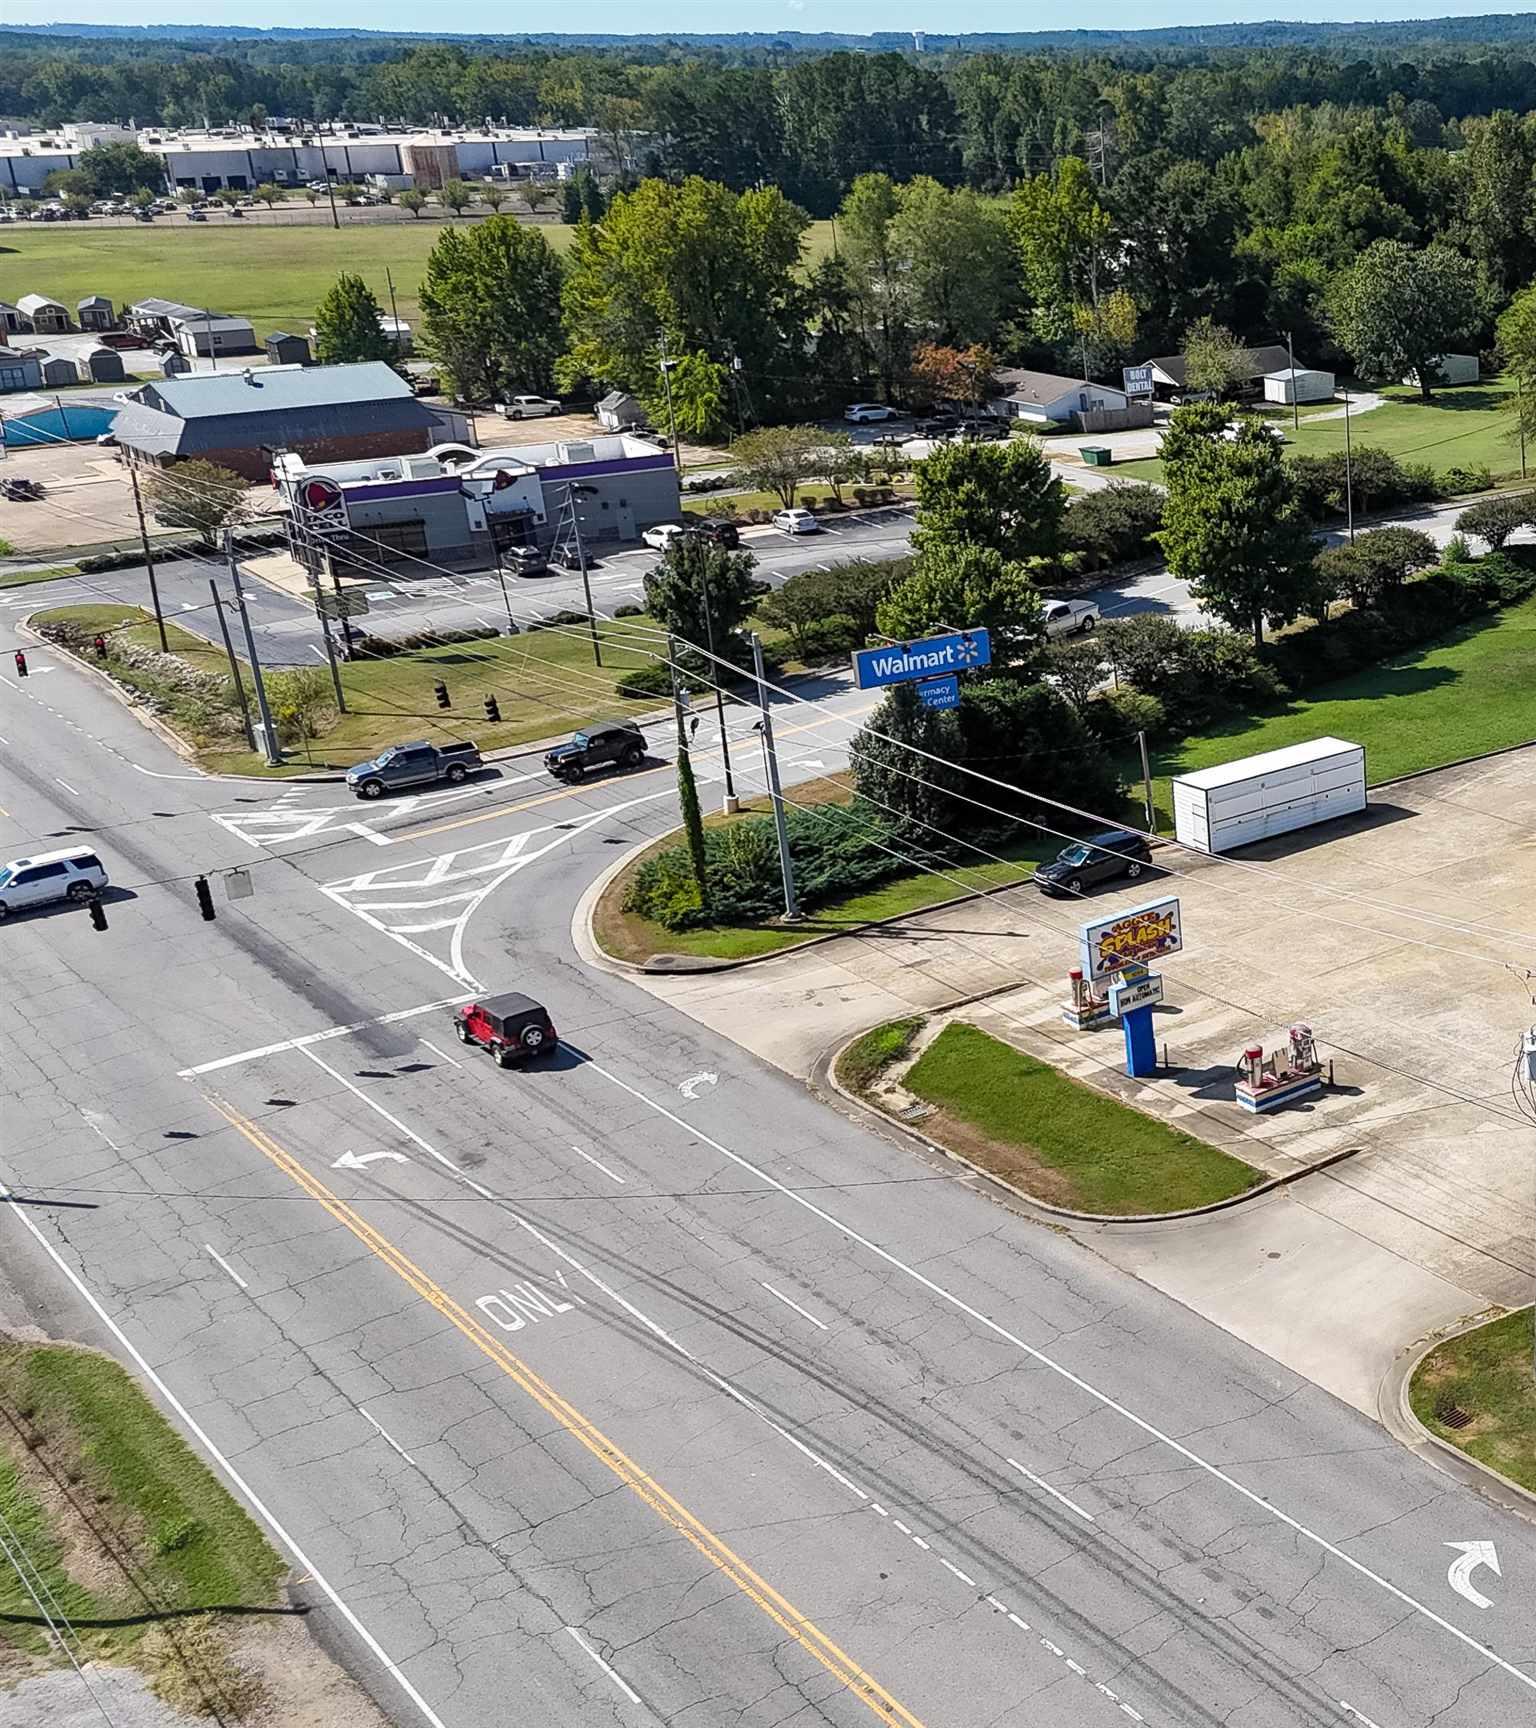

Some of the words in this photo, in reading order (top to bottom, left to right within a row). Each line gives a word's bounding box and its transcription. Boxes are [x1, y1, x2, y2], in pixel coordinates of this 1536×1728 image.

[872, 645, 955, 678] Walmart
[928, 695, 955, 706] Center
[1100, 916, 1172, 958] SPLASH
[475, 1270, 587, 1332] ONLY
